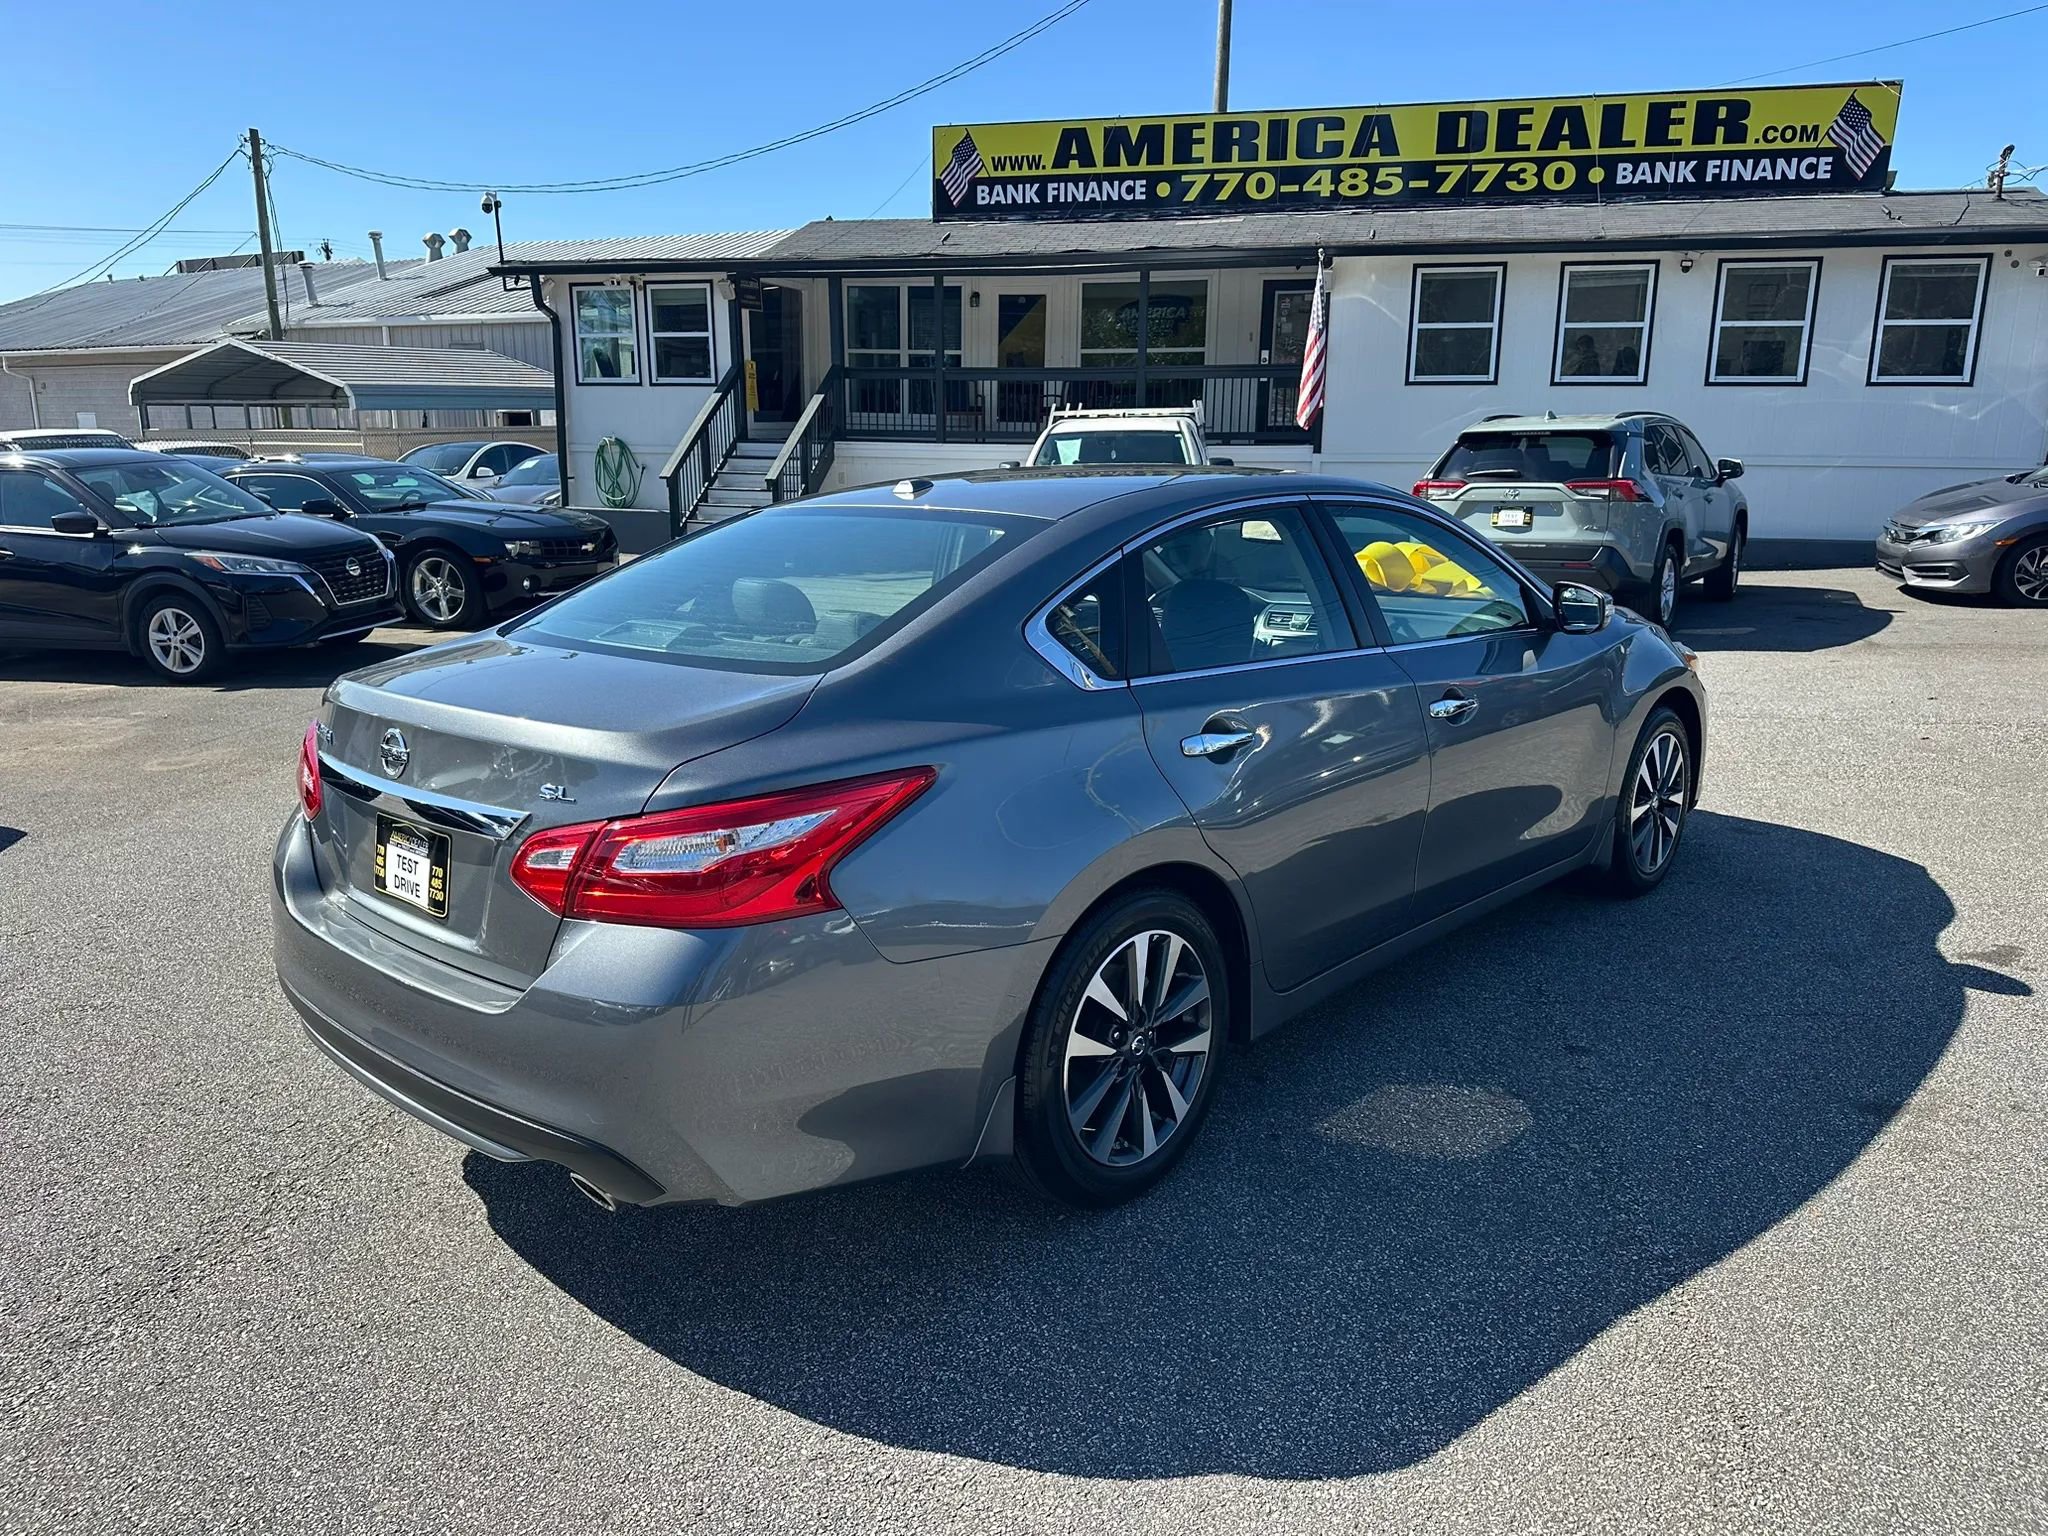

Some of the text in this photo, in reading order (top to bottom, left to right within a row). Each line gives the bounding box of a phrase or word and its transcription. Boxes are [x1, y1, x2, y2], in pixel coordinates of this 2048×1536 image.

[976, 156, 1833, 206] BANK FINANCE 770-485-7730 BANK FINANCE
[539, 783, 577, 803] SL
[396, 854, 419, 876] TEST
[431, 865, 444, 879] 770
[394, 874, 421, 899] DRIVE
[430, 877, 443, 891] 485
[429, 887, 444, 902] 7730
